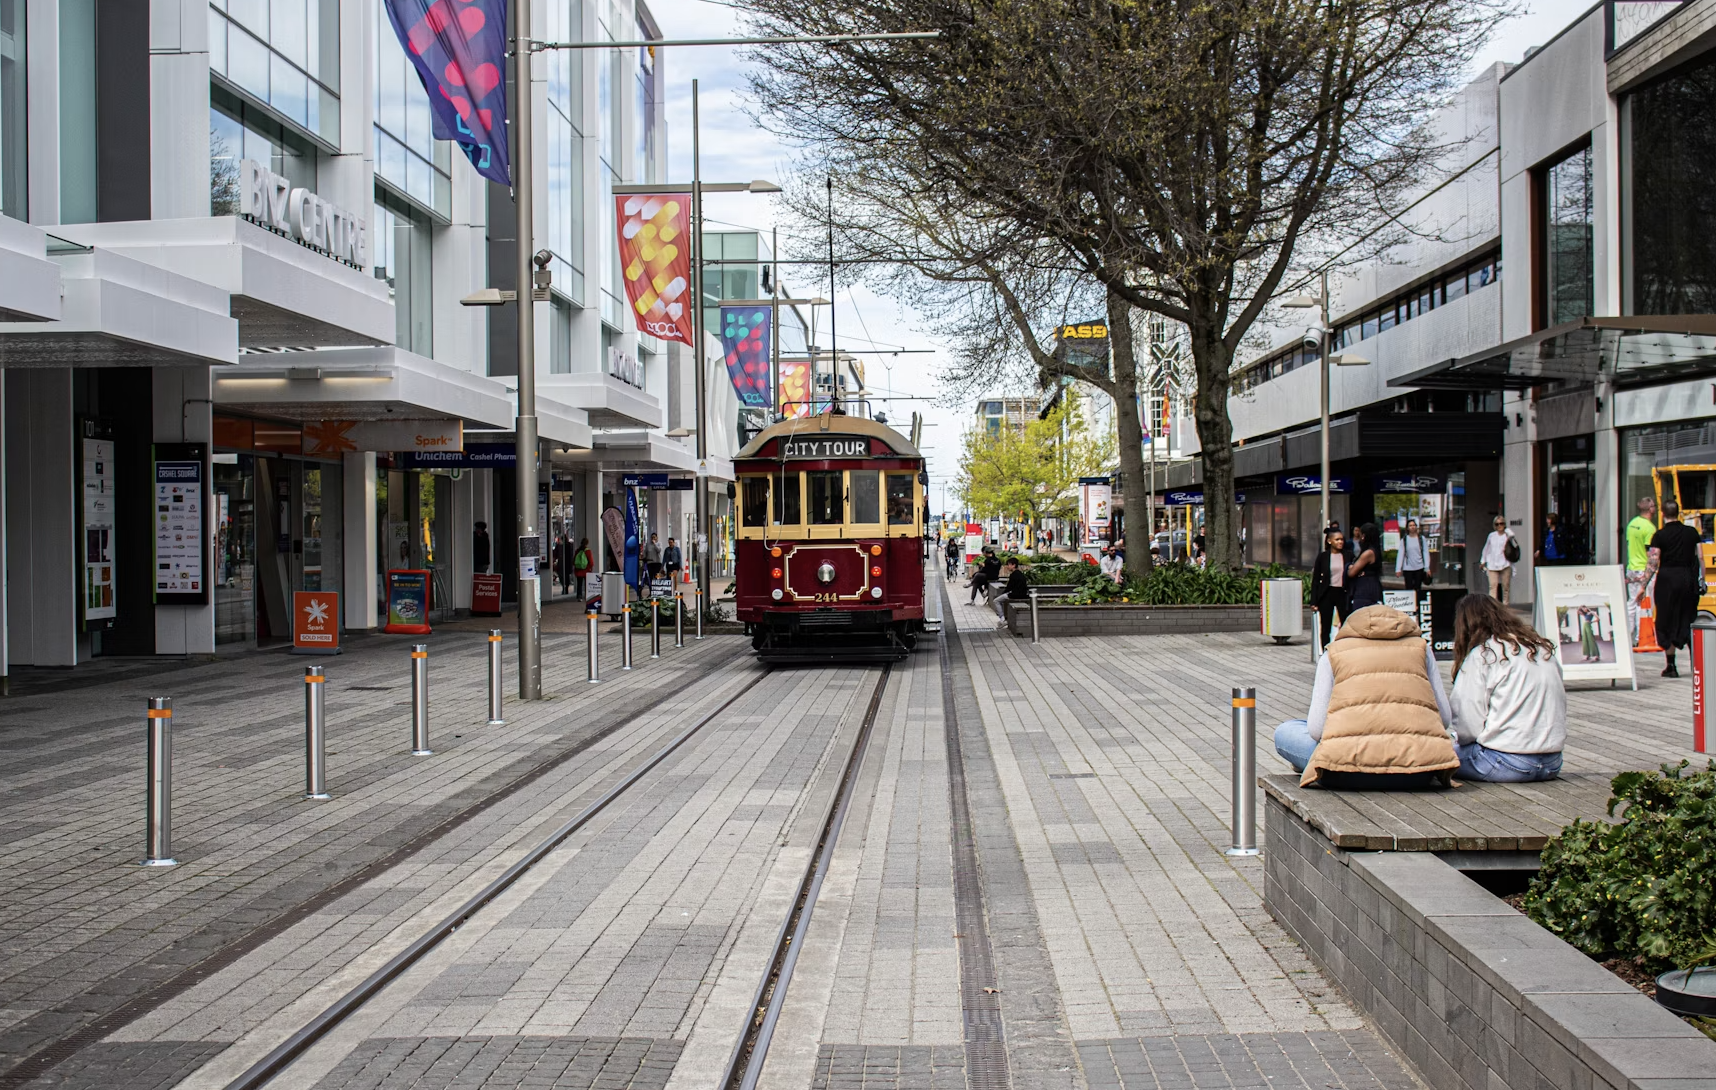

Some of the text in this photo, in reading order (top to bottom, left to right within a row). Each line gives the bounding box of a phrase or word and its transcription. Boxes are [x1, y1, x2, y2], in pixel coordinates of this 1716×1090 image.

[241, 159, 367, 267] BNZ CENTRE
[1062, 325, 1107, 338] ASB
[415, 435, 447, 447] Spark
[785, 441, 866, 455] CITY TOUR
[415, 450, 463, 461] Unichem
[493, 453, 516, 461] Pharm
[815, 592, 838, 602] 244
[307, 624, 325, 632] Spark
[1434, 642, 1456, 650] OPE
